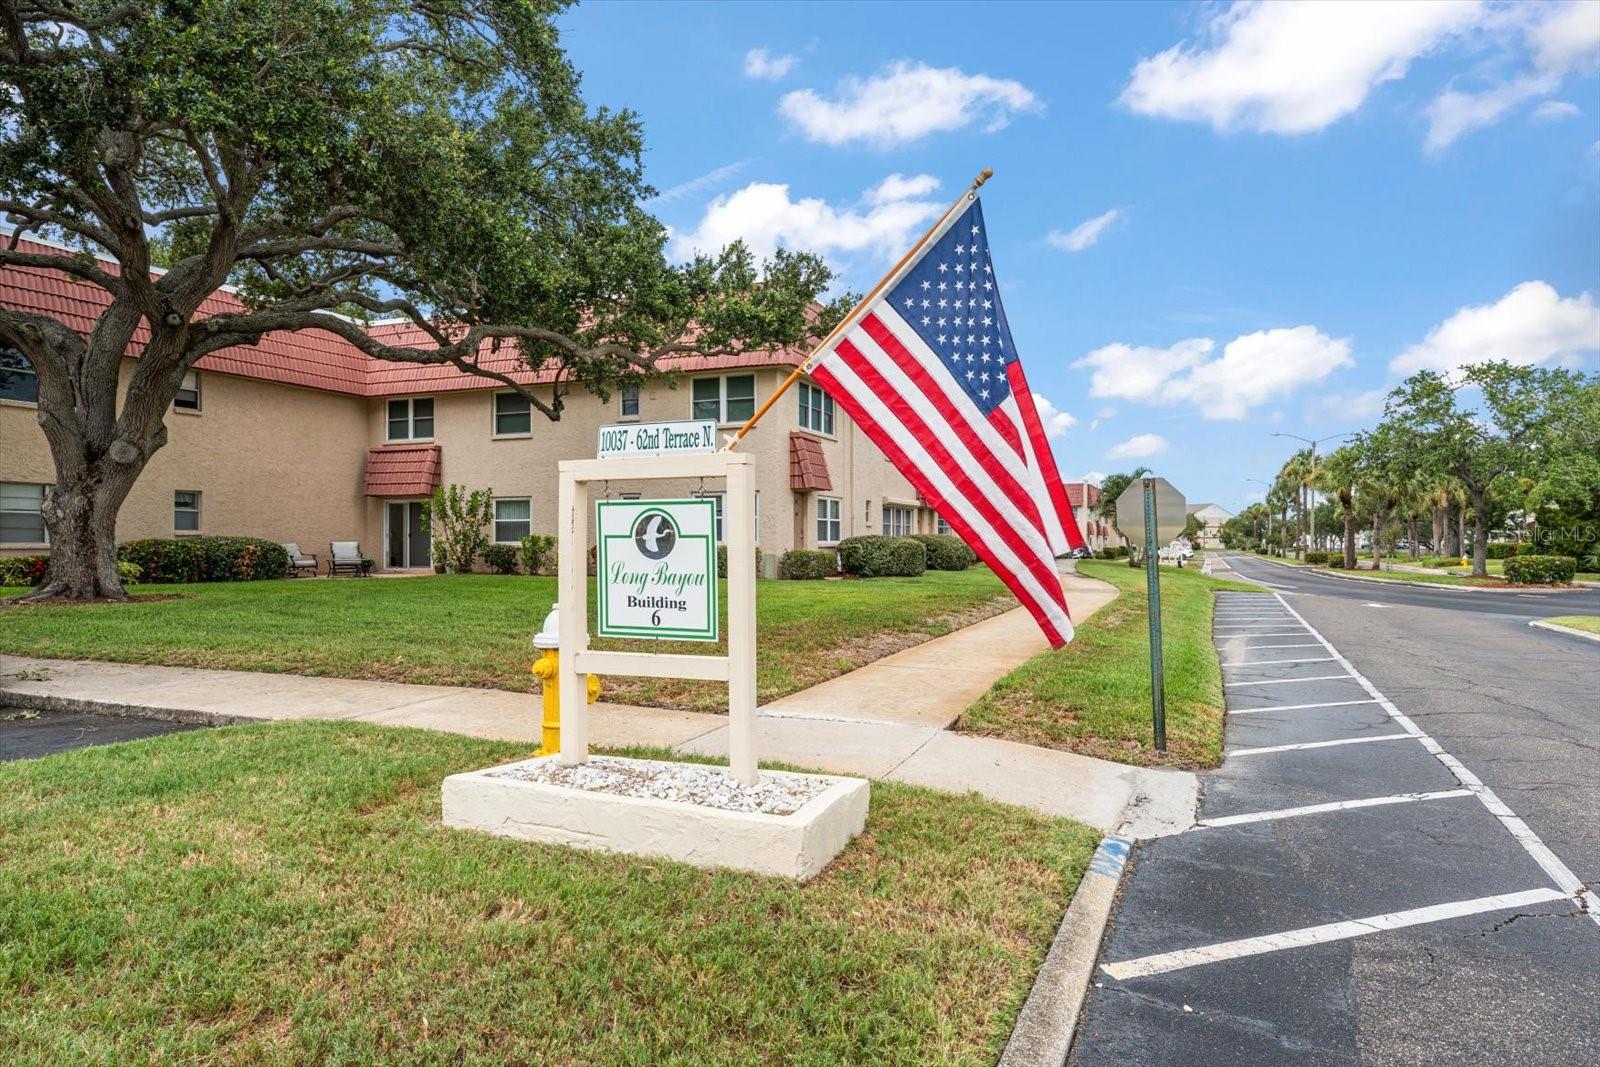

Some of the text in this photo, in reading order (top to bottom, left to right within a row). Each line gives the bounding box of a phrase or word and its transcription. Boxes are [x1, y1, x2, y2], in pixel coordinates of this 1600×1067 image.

[600, 430, 628, 452] 10037
[636, 428, 659, 450] 62nd
[663, 427, 700, 449] Terrace
[702, 425, 714, 447] N.
[610, 560, 705, 596] Long Bayou
[627, 595, 687, 611] Building
[651, 609, 661, 626] 6
